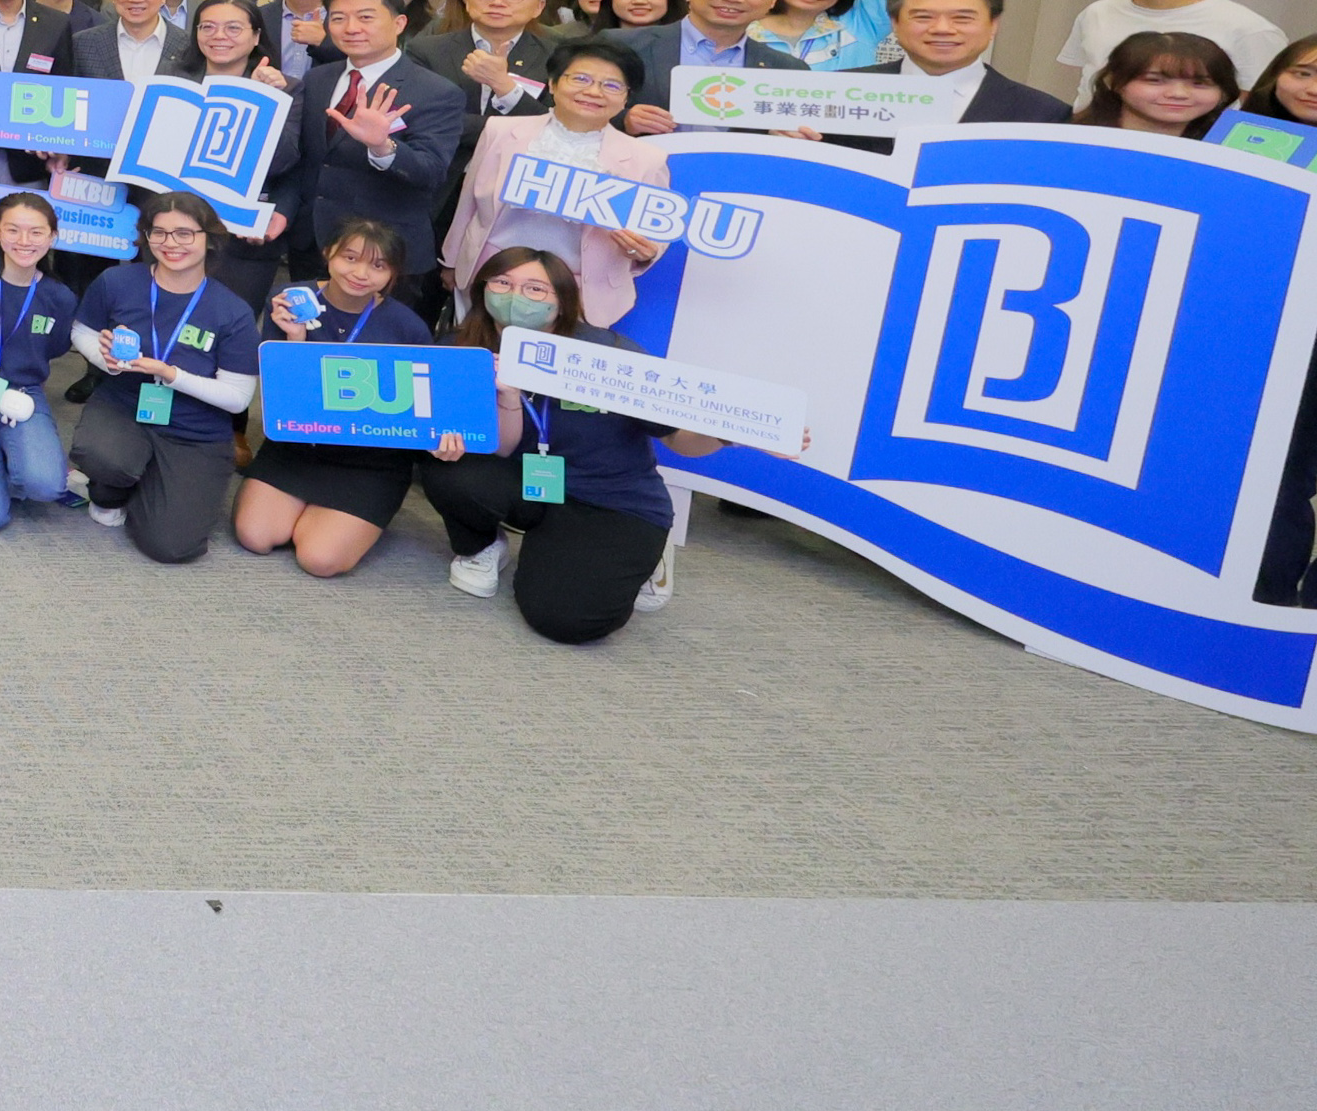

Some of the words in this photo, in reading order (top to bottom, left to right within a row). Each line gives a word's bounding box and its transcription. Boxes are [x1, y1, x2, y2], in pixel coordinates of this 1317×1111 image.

[10, 81, 89, 131] BUi
[753, 100, 895, 122] 事業策劃中心
[754, 84, 839, 104] Career
[845, 87, 934, 105] Centre
[27, 133, 75, 147] i-ConNet
[62, 176, 116, 204] HKBU
[503, 154, 763, 259] HKBU
[321, 355, 432, 418] BUi
[566, 353, 718, 395] 香港浸會大學
[563, 366, 596, 383] HONG
[601, 376, 635, 392] KONG
[640, 384, 694, 405] BAPTIST
[699, 398, 782, 426] UNIVERSITY
[276, 418, 341, 436] i-Explore
[350, 422, 418, 439] i-ConNet
[651, 402, 700, 422] SCHOOL
[703, 417, 719, 427] OF
[721, 419, 780, 442] BUSINESS
